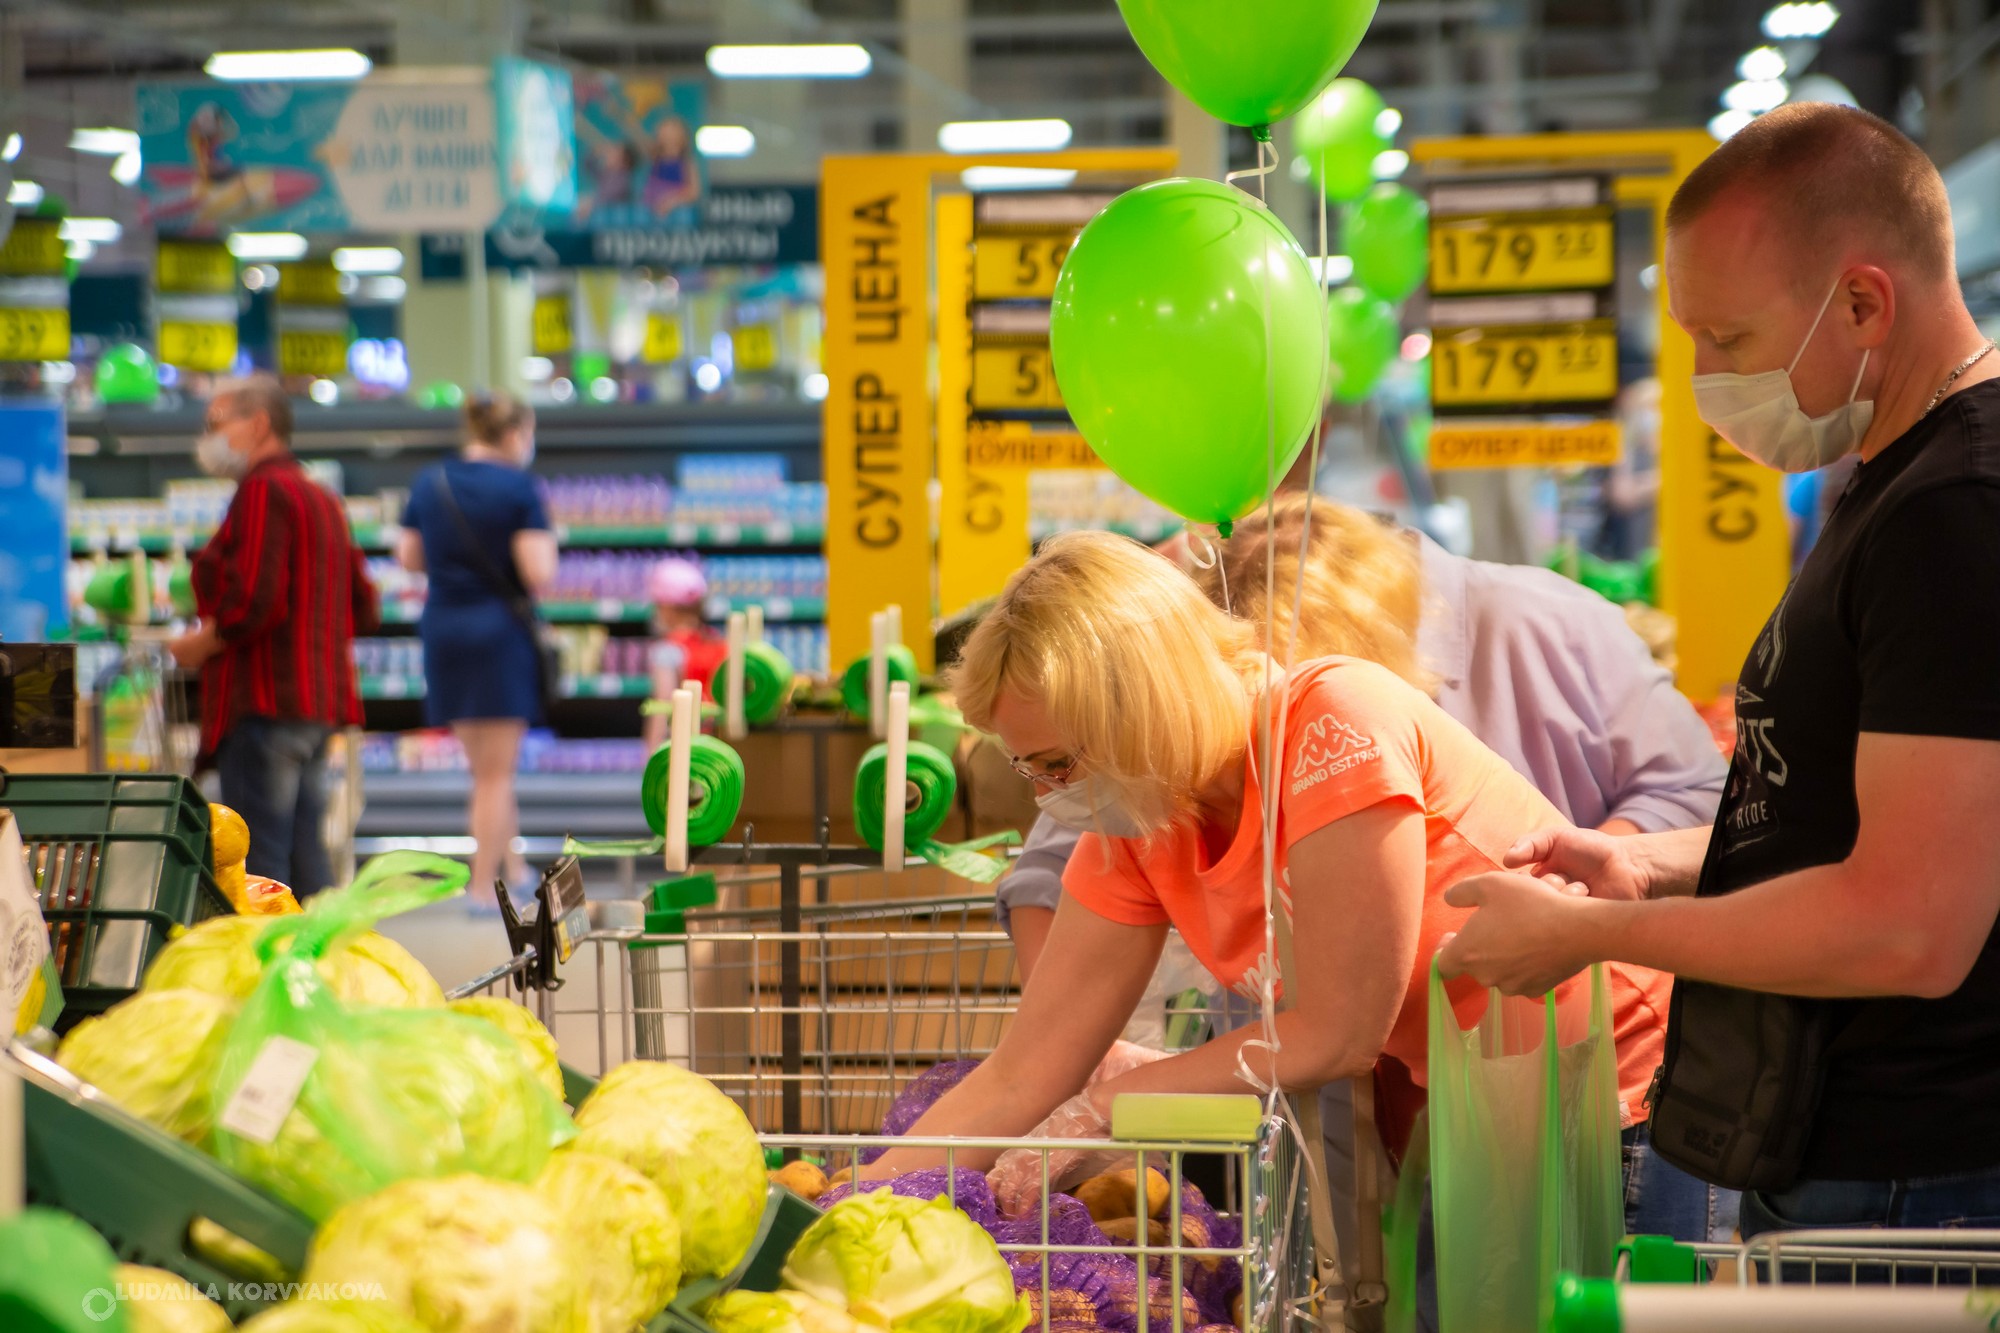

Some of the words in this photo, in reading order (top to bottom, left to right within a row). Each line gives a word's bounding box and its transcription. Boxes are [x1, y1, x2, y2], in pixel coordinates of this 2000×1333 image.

[592, 228, 780, 266] продукты
[1443, 231, 1536, 278] 179
[852, 192, 910, 345] ЦЕНА
[1444, 345, 1539, 390] 179
[854, 372, 904, 550] СУПЕР
[974, 443, 1063, 466] СУПЕР
[1439, 435, 1527, 459] СУПЕР
[1534, 433, 1612, 457] ЦЕНА
[1291, 767, 1329, 796] BRAND
